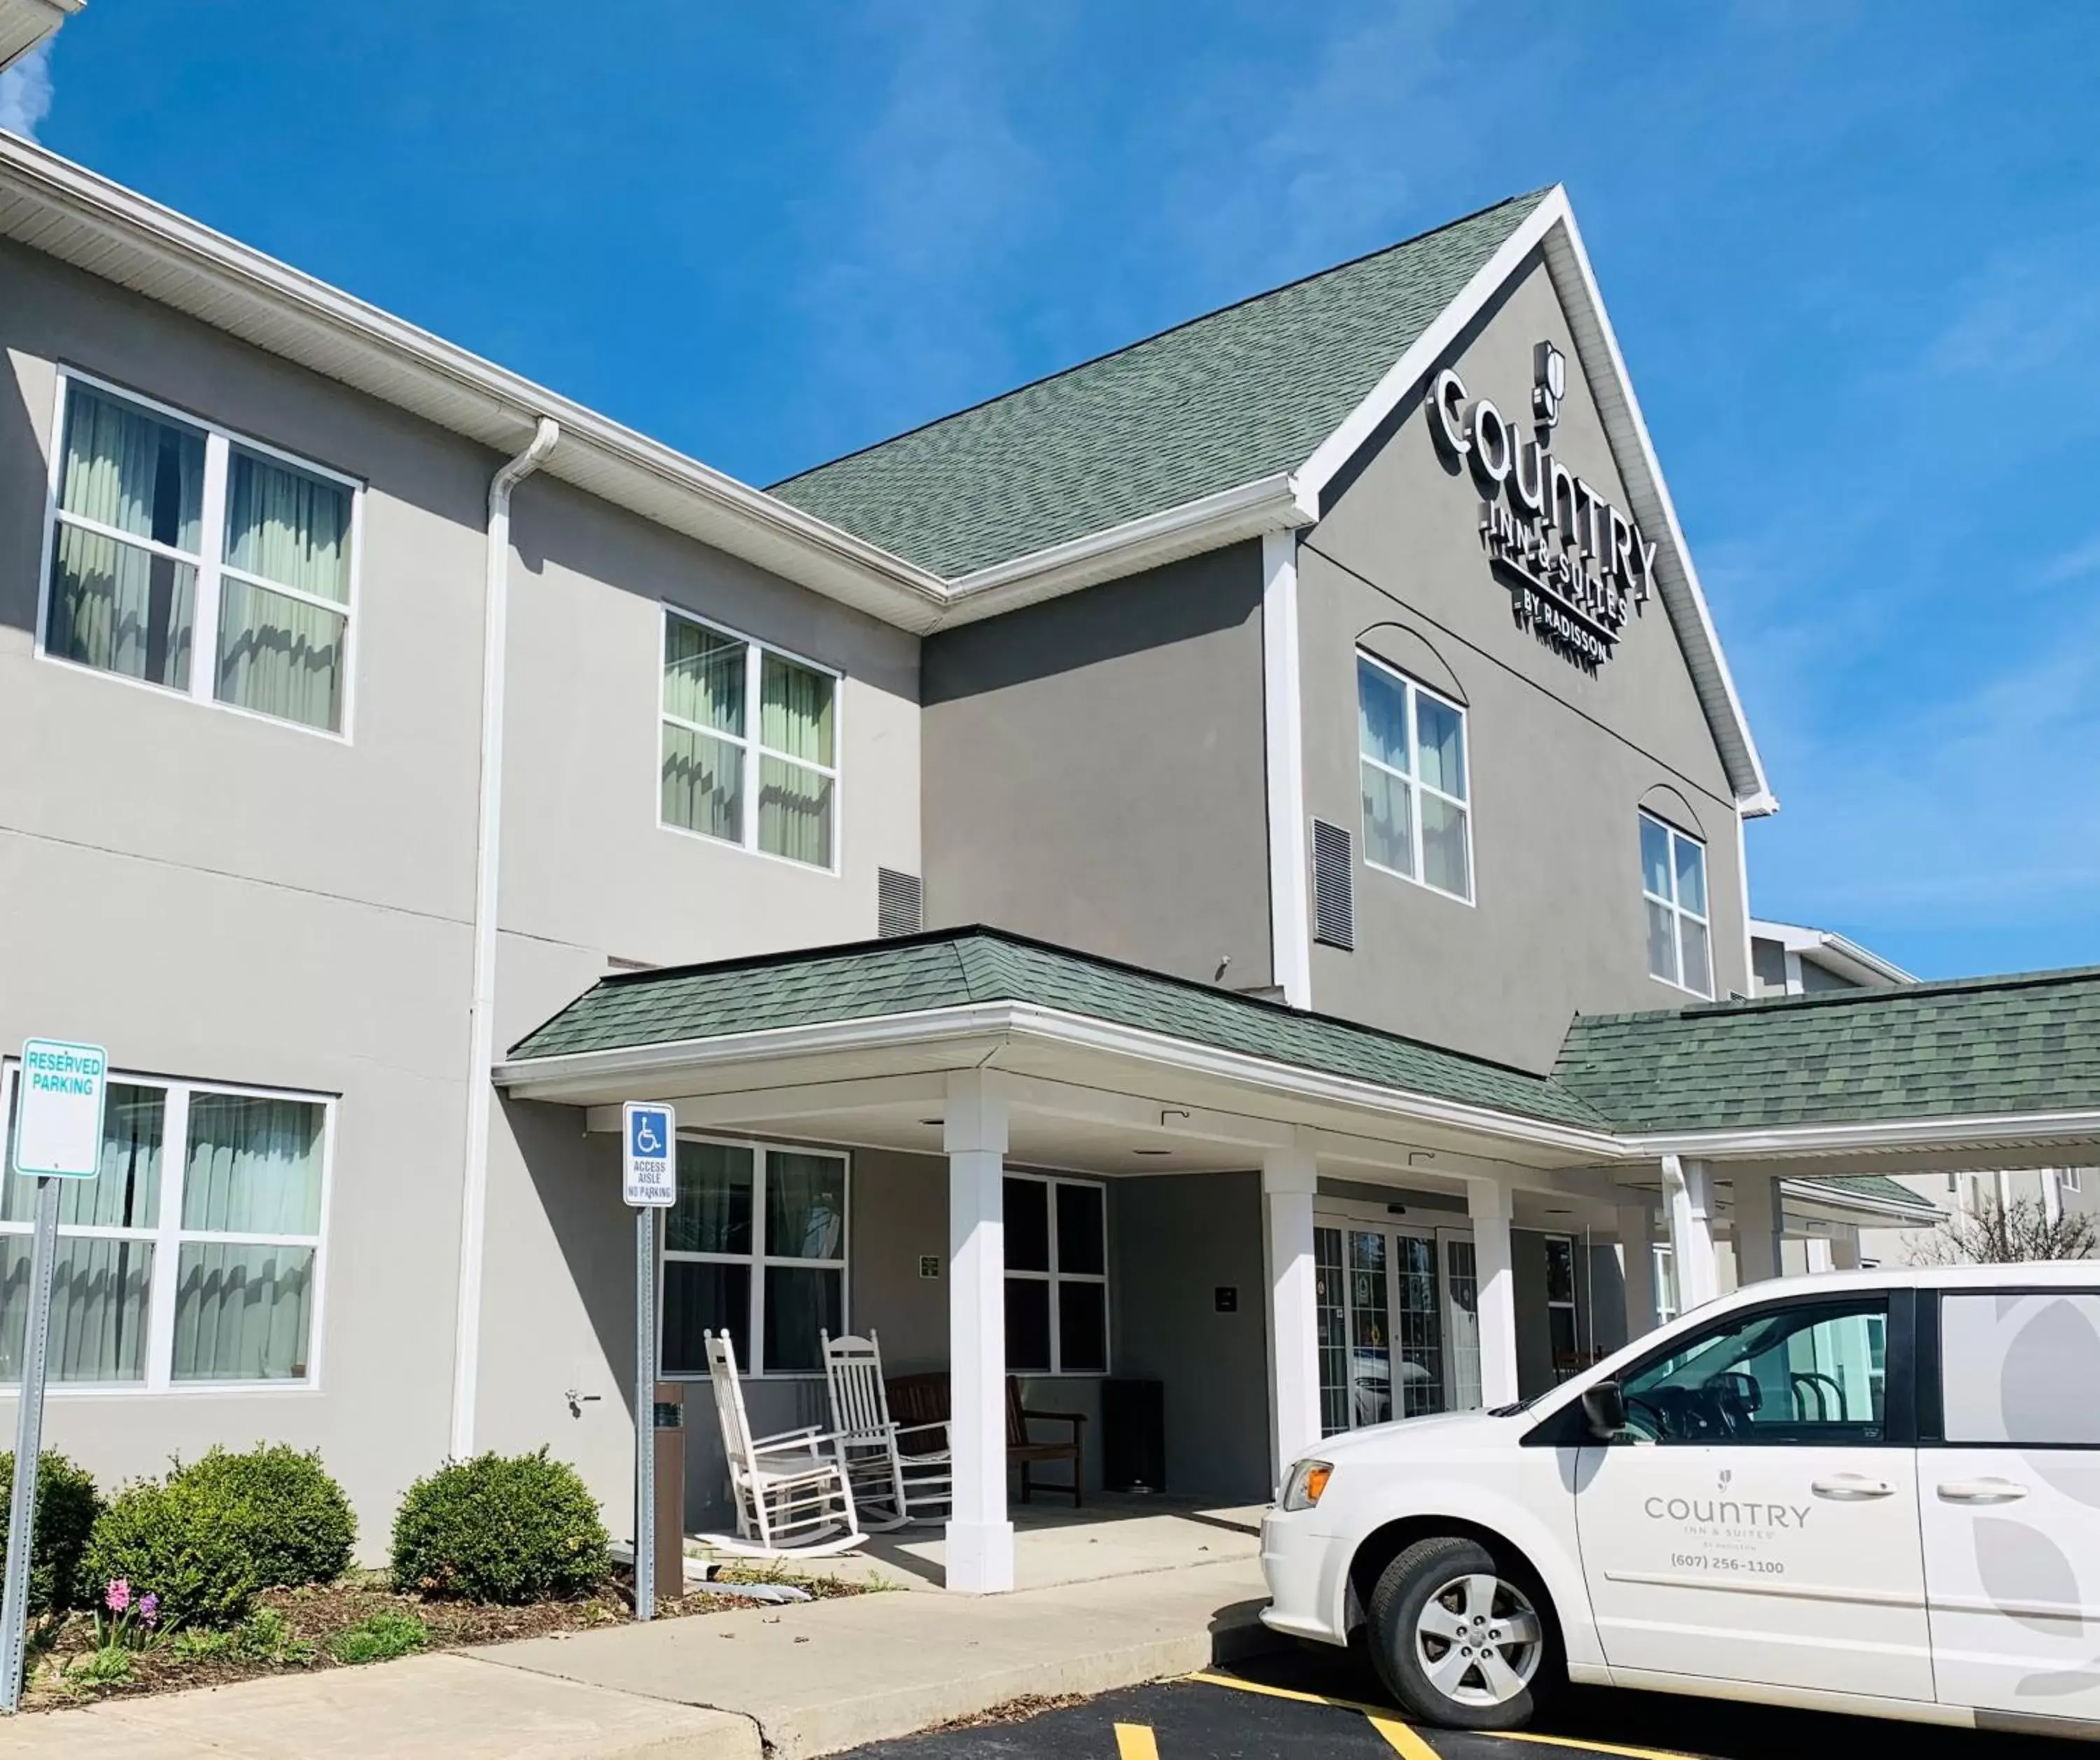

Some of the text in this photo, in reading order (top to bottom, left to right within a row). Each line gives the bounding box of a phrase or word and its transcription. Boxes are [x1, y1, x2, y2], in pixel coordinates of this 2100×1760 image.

[1488, 500, 1628, 626] INN & SUITES
[1524, 588, 1607, 663] BY RADISSON
[29, 1052, 101, 1075] RESERVED
[33, 1073, 93, 1096] PARKING
[634, 1161, 666, 1173] ACCESS
[638, 1173, 661, 1184] AISLE
[628, 1186, 671, 1199] NO PARKING
[1671, 1553, 1785, 1574] (607) 256-1100
